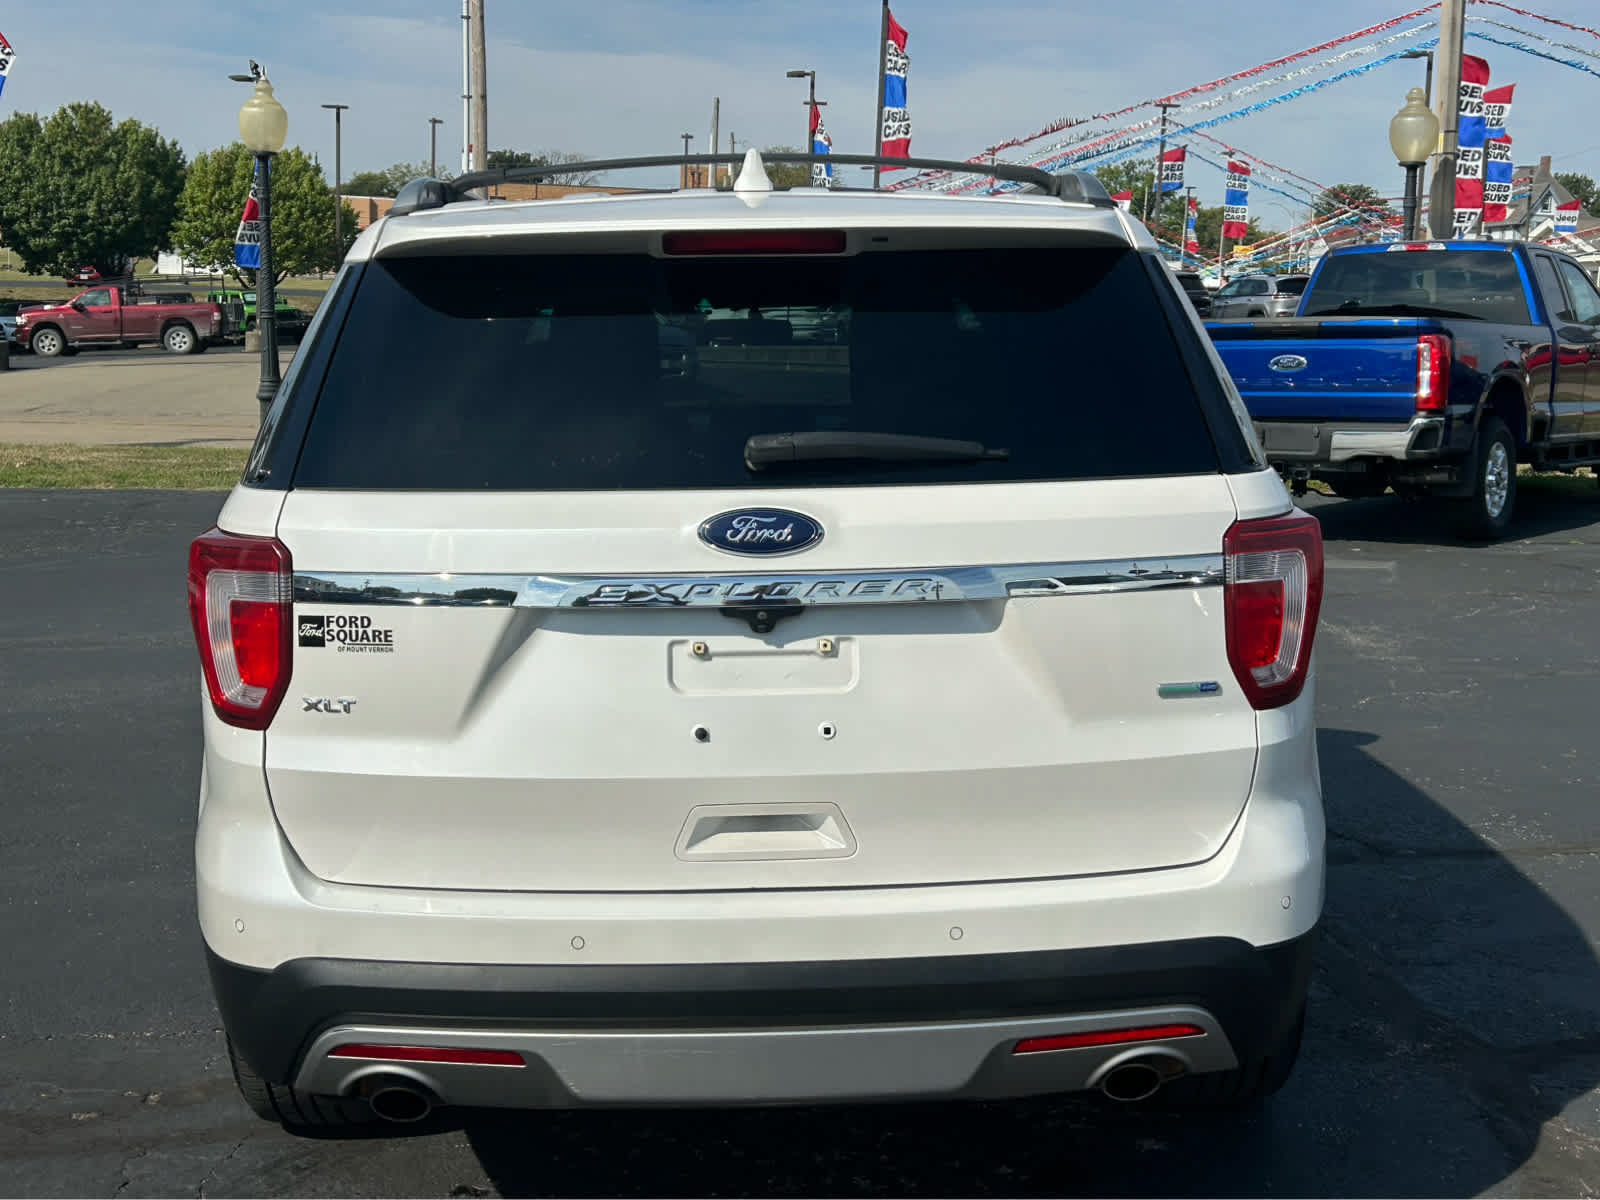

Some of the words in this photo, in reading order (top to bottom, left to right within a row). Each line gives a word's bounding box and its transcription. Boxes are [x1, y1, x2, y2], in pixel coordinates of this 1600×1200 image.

[1459, 100, 1483, 114] UVS
[1485, 104, 1504, 117] SED
[1163, 163, 1184, 172] SED
[1161, 172, 1184, 181] ARS
[1555, 213, 1577, 223] Jeep
[726, 516, 794, 543] Ford
[590, 577, 943, 605] EXPLORER
[326, 615, 372, 629] FORD
[299, 623, 324, 637] Ford
[326, 629, 394, 645] SQUARE
[302, 697, 357, 714] XLT
